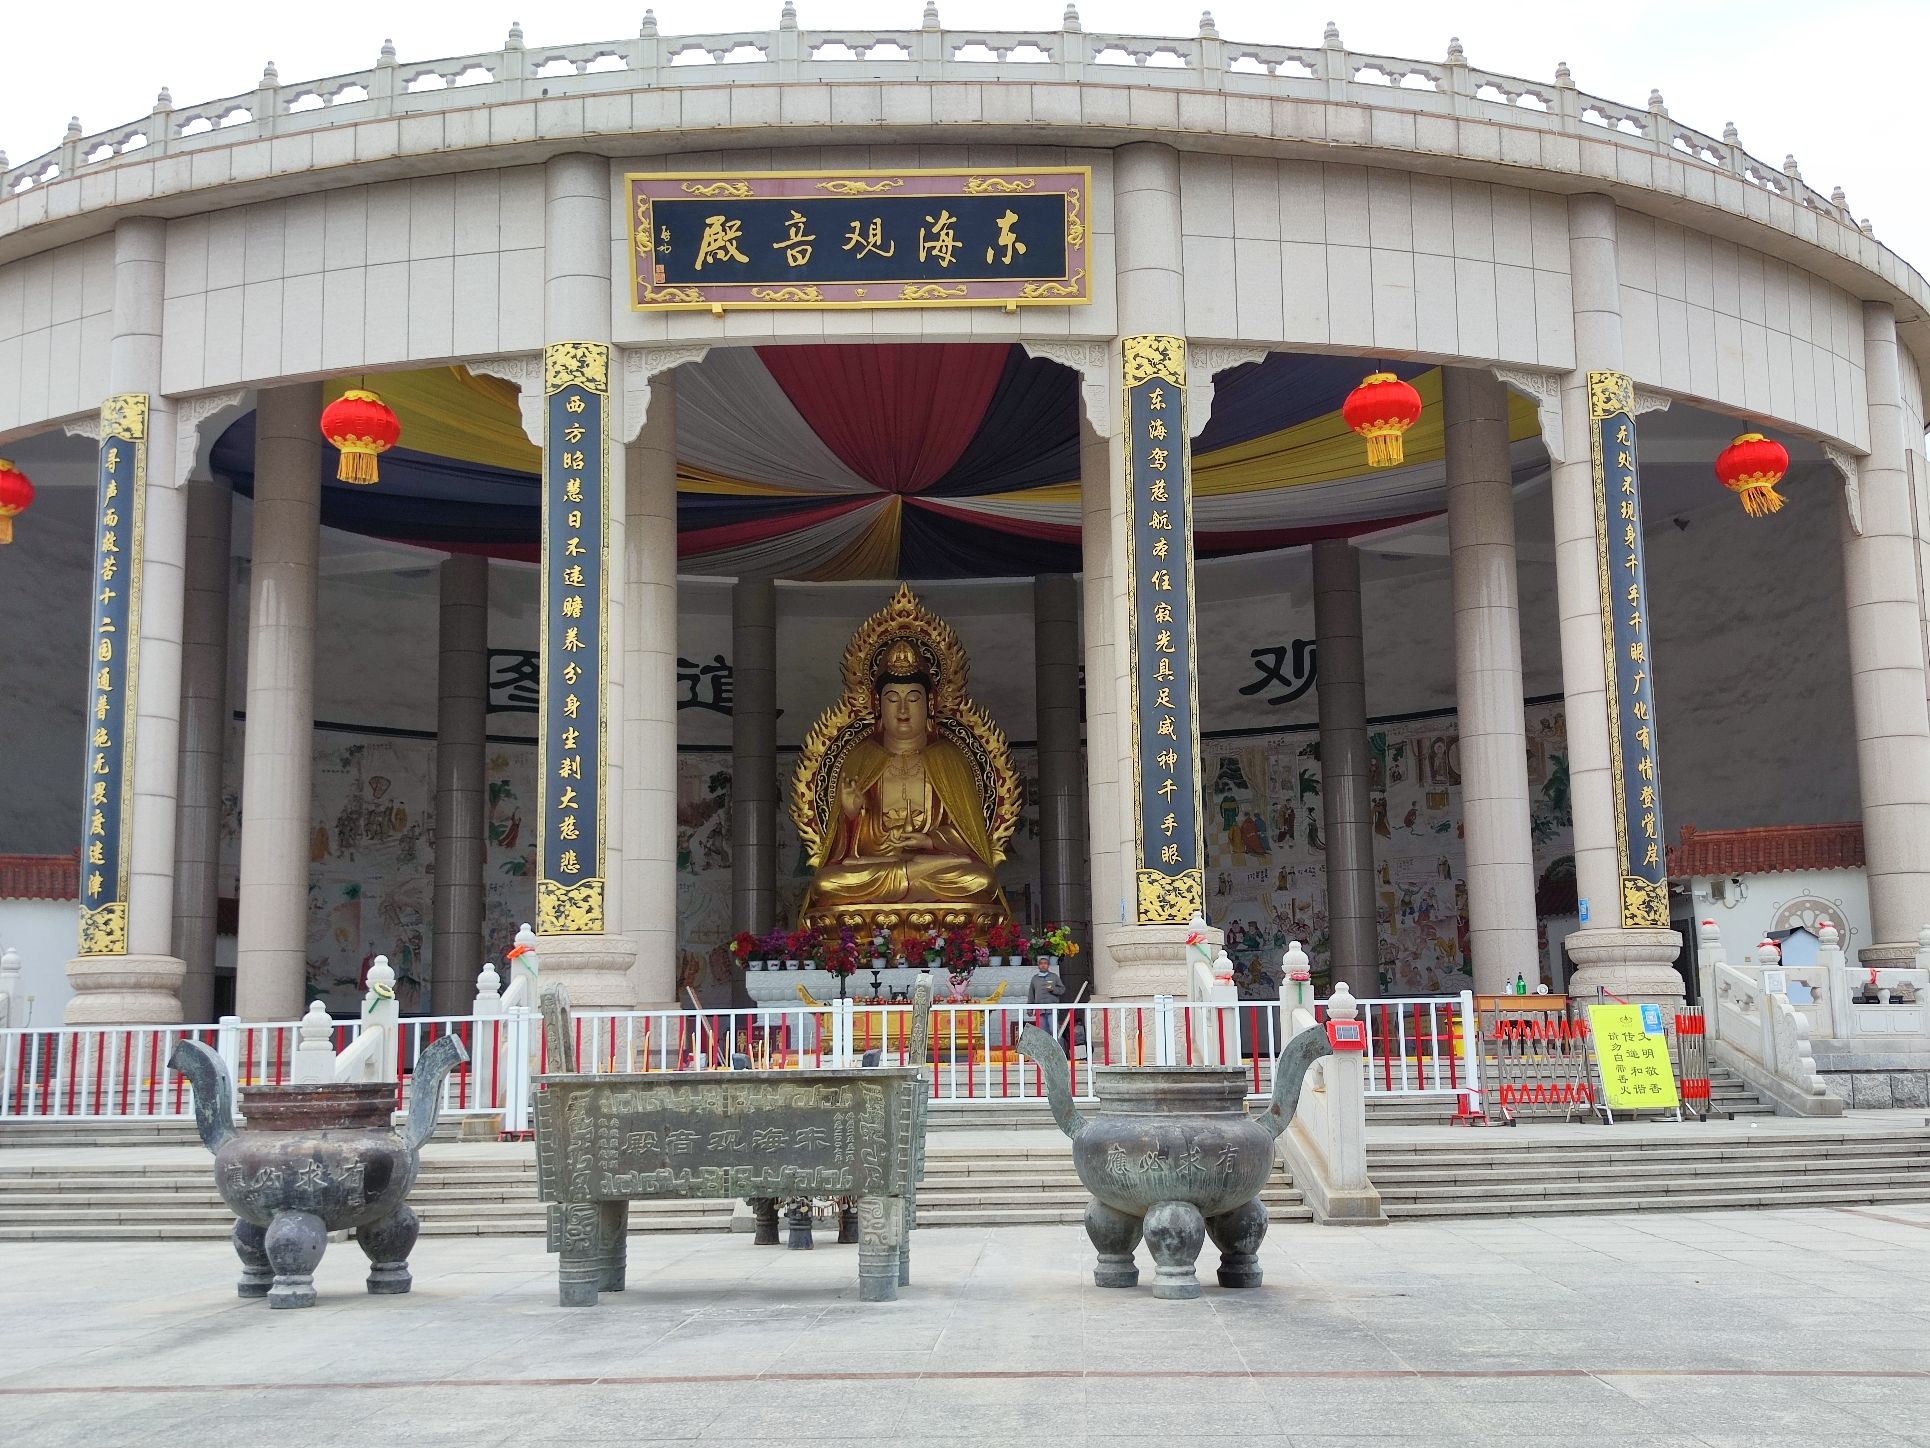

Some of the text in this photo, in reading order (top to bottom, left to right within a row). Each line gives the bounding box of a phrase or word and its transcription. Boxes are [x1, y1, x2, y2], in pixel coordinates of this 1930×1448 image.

[693, 209, 1027, 270] 东海观音殿
